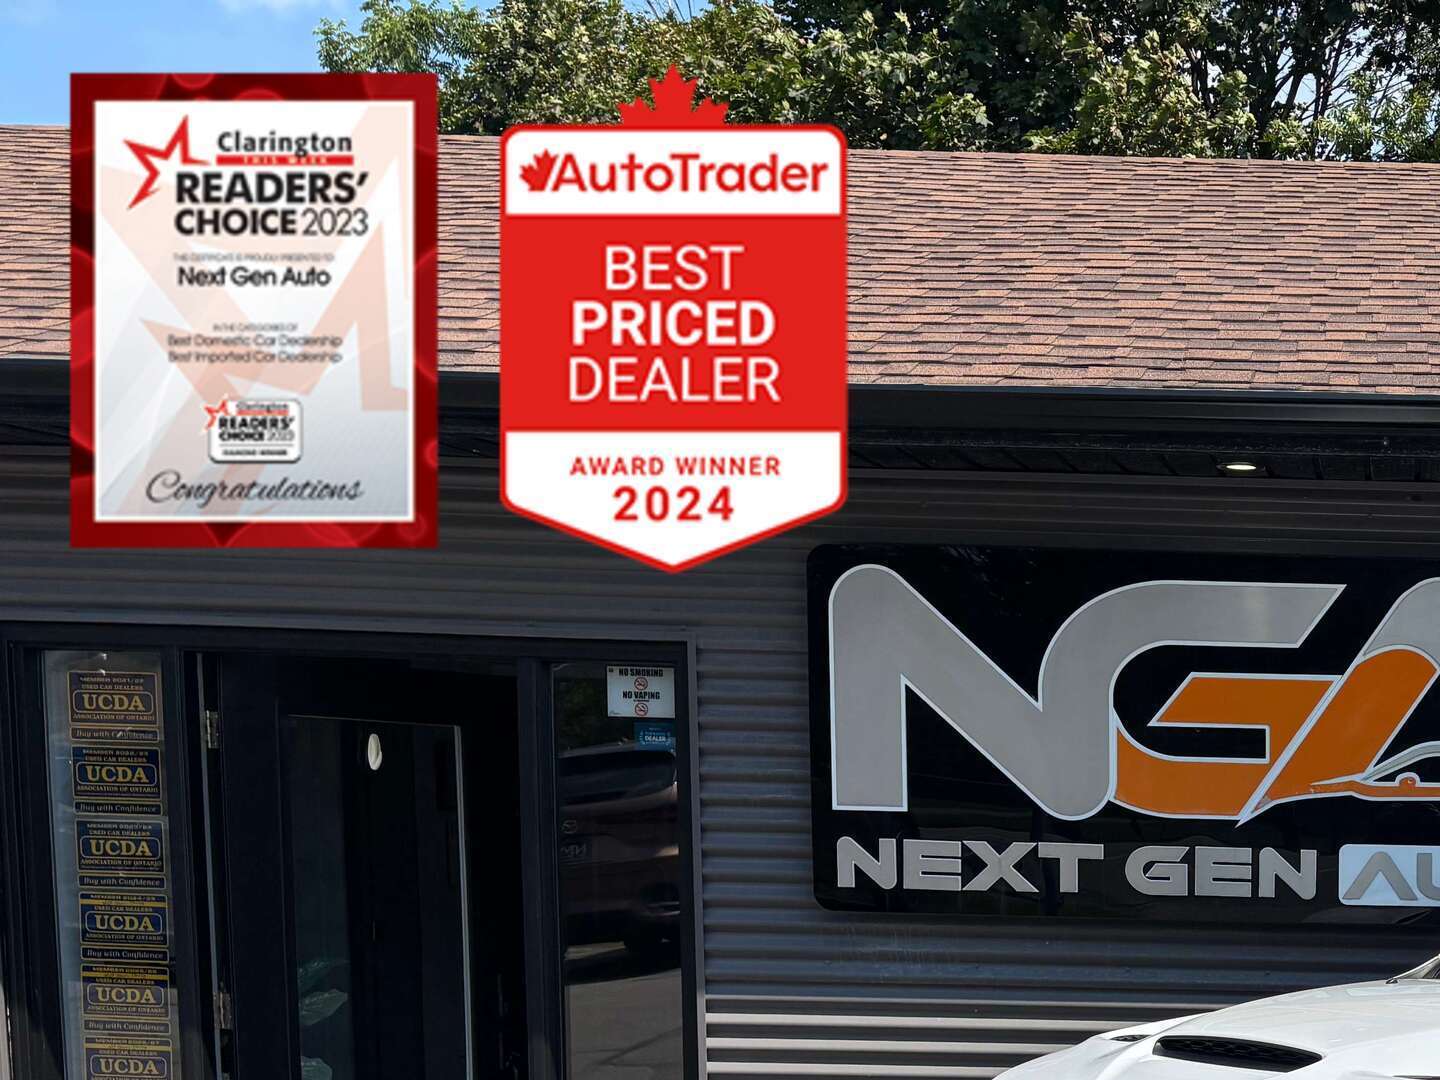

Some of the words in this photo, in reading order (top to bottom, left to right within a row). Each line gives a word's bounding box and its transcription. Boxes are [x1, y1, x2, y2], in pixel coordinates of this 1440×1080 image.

[618, 668, 629, 677] NO
[630, 668, 664, 677] SMOKING
[82, 693, 146, 711] UCDA
[622, 690, 633, 699] NO
[633, 691, 661, 700] VAPING
[85, 765, 149, 783] UCDA
[89, 839, 153, 857] UCDA
[835, 836, 1104, 894] NEXT
[1124, 845, 1317, 901] GEN
[94, 914, 155, 931] UCDA
[95, 987, 156, 1004] UCDA
[99, 1058, 160, 1075] UCDA
